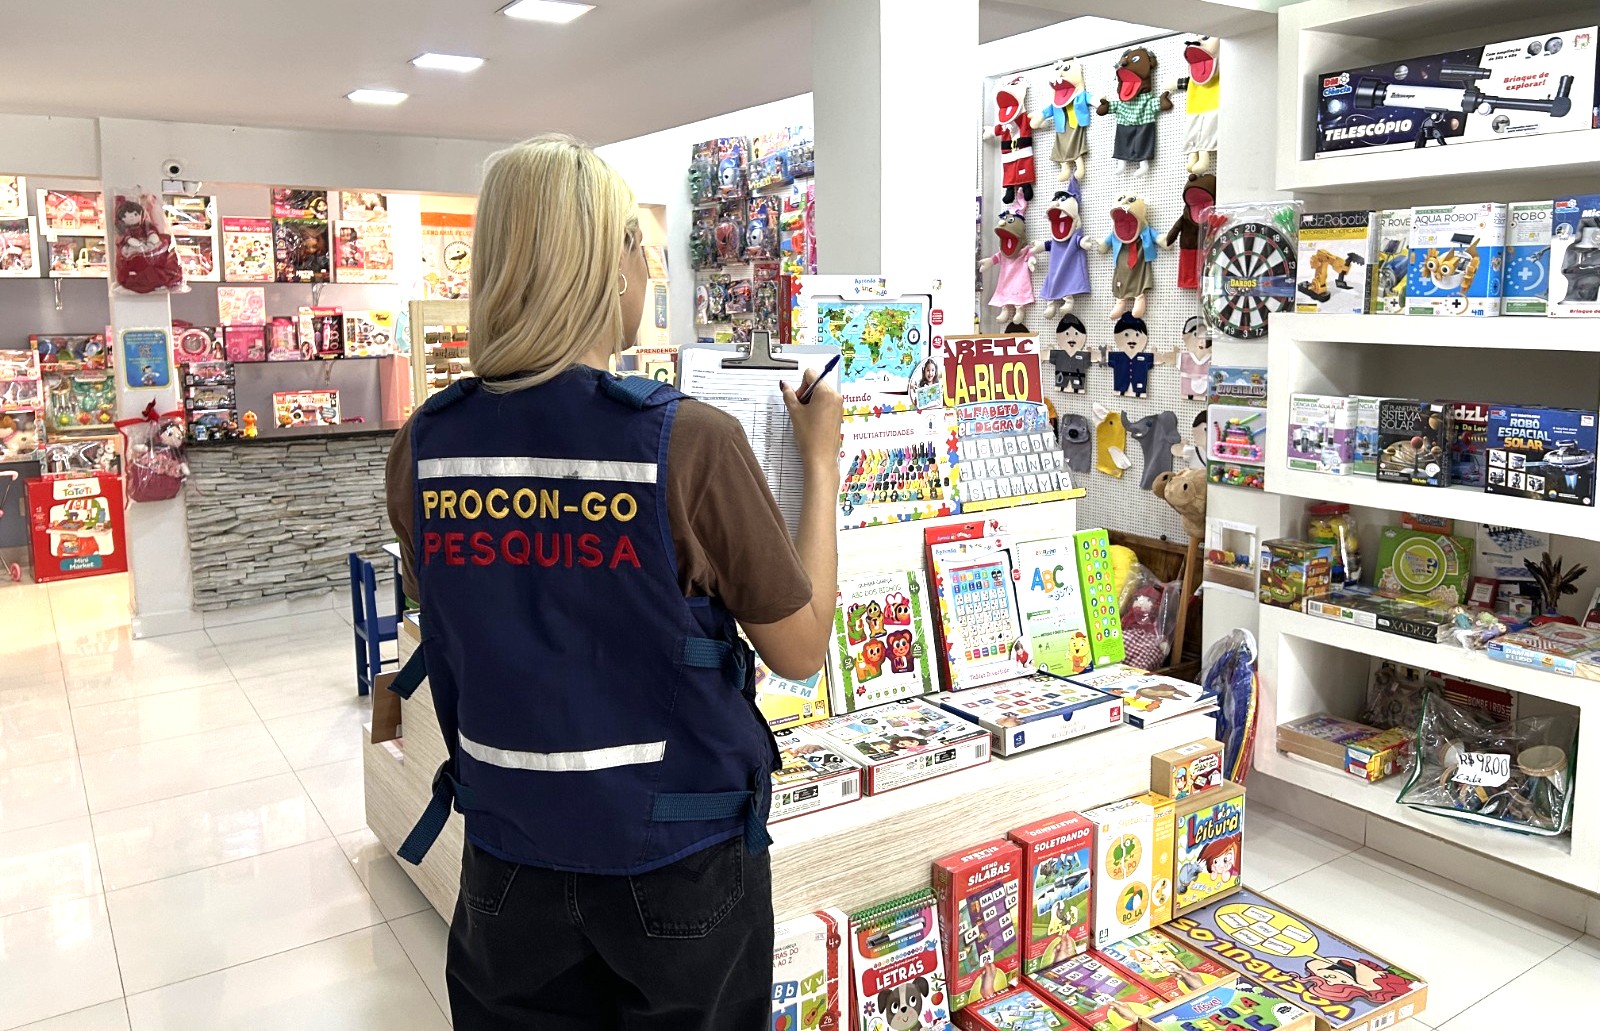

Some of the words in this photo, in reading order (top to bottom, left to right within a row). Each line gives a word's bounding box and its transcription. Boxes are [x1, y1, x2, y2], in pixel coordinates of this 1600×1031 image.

[1503, 74, 1537, 84] Brinque
[1538, 71, 1549, 79] de
[1505, 80, 1546, 91] explorar!
[1324, 119, 1413, 141] TELESCÓPIO
[1415, 214, 1442, 225] AQUA
[1444, 212, 1479, 222] ROBOT
[1513, 211, 1547, 221] ROBO
[1244, 224, 1256, 232] 20
[1388, 218, 1410, 227] ROVE
[1212, 248, 1217, 256] 9
[1288, 261, 1296, 269] 13
[1243, 329, 1248, 337] 3
[653, 368, 669, 383] C
[842, 393, 872, 402] Mundo
[957, 403, 1019, 419] ALFABETO
[1381, 410, 1422, 421] SISTEMA
[1381, 420, 1414, 431] SOLAR
[1510, 418, 1540, 429] ROBÔ
[853, 428, 915, 440] MULTIATIVIDADES
[1498, 427, 1552, 441] ESPACIAL
[1007, 442, 1013, 453] B
[1020, 441, 1028, 451] C
[1034, 439, 1041, 450] D
[1504, 438, 1544, 450] SOLAR
[961, 467, 969, 478] H
[990, 464, 997, 475] K
[1004, 463, 1010, 474] L
[1016, 461, 1025, 472] M
[1030, 460, 1038, 471] N
[1044, 458, 1051, 469] P
[972, 488, 980, 499] S
[986, 486, 993, 497] T
[1001, 484, 1008, 496] V
[1011, 483, 1021, 494] W
[1027, 482, 1036, 493] X
[1041, 480, 1048, 491] Y
[422, 488, 637, 522] PROCON-GO
[423, 530, 641, 568] PESQUISA
[69, 562, 95, 570] Market
[1031, 564, 1065, 593] ABC
[872, 618, 878, 626] T
[1390, 619, 1435, 638] XADREZ
[857, 652, 863, 661] L
[970, 671, 988, 681] Tablet
[768, 678, 812, 698] TREM
[1467, 696, 1506, 715] BOMBEIROS
[1460, 753, 1475, 767] R$
[1476, 754, 1509, 777] 98,00
[1456, 773, 1482, 783] cada
[1187, 811, 1239, 848] Leitura
[1034, 828, 1091, 853] SOLETRANDO
[967, 862, 1011, 886] SÍLABAS
[1112, 866, 1123, 877] SA
[1127, 860, 1137, 871] PO
[1008, 884, 1018, 892] NA
[981, 896, 992, 905] MA
[994, 889, 1003, 898] LA
[1007, 896, 1016, 905] LO
[985, 909, 995, 918] BO
[1122, 912, 1132, 922] BO
[1134, 908, 1143, 917] LA
[1001, 916, 1010, 925] SA
[967, 930, 977, 940] CA
[1004, 928, 1013, 937] TO
[828, 938, 840, 948] 4+
[789, 947, 799, 955] DO
[777, 960, 787, 968] AO
[788, 956, 793, 964] Z
[982, 954, 992, 963] PA
[1170, 917, 1356, 1021] VOCÁBULOS
[875, 960, 925, 991] LETRAS
[774, 984, 784, 999] B
[785, 983, 795, 997] b
[803, 979, 813, 991] V
[823, 1016, 833, 1025] 26
